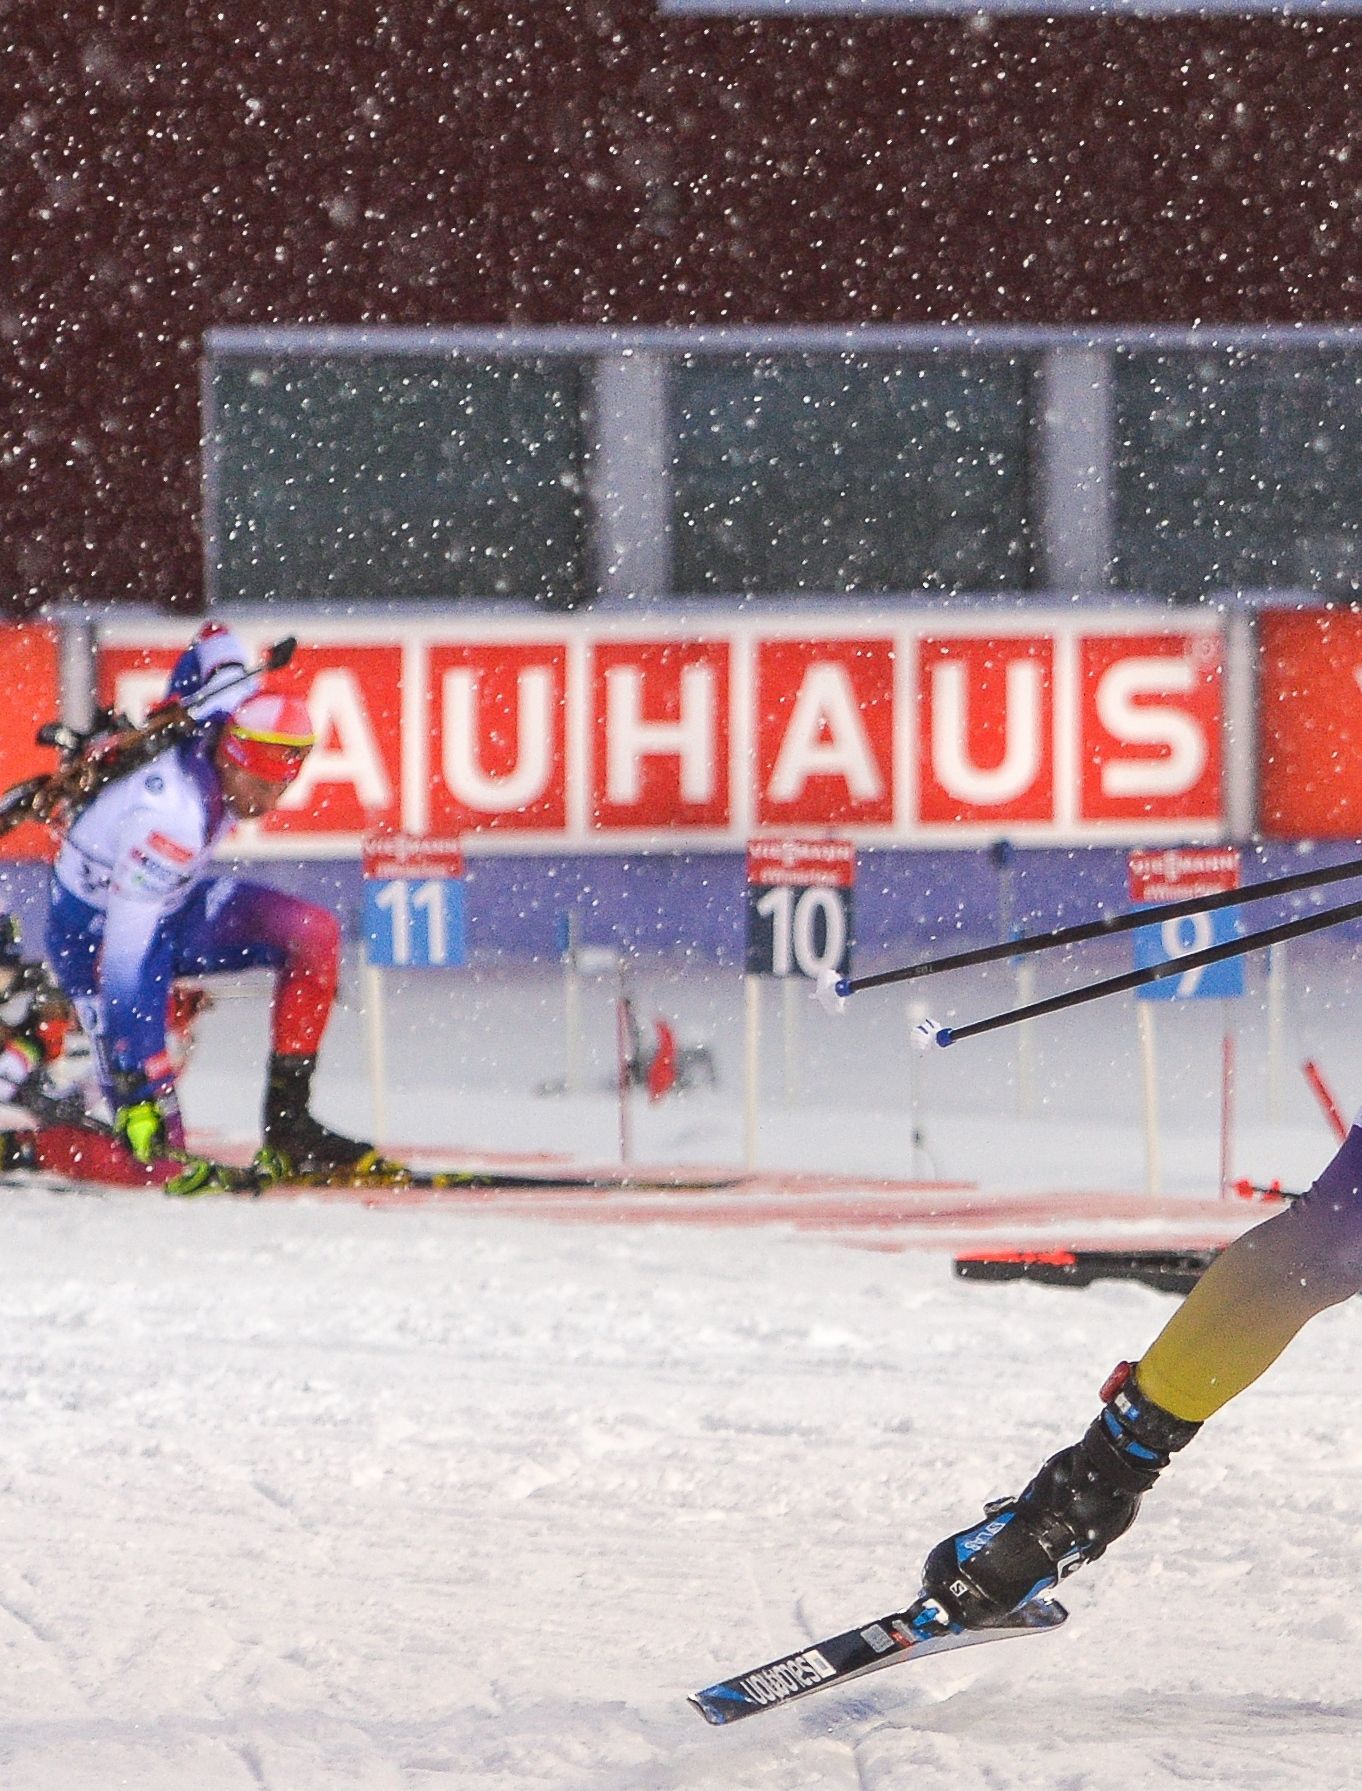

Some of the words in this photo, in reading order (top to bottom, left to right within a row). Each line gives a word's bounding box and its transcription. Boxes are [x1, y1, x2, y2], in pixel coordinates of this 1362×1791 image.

[114, 656, 1207, 812] AUHAUS
[375, 880, 447, 964] 11
[756, 886, 846, 979] 10
[1160, 908, 1214, 998] 9
